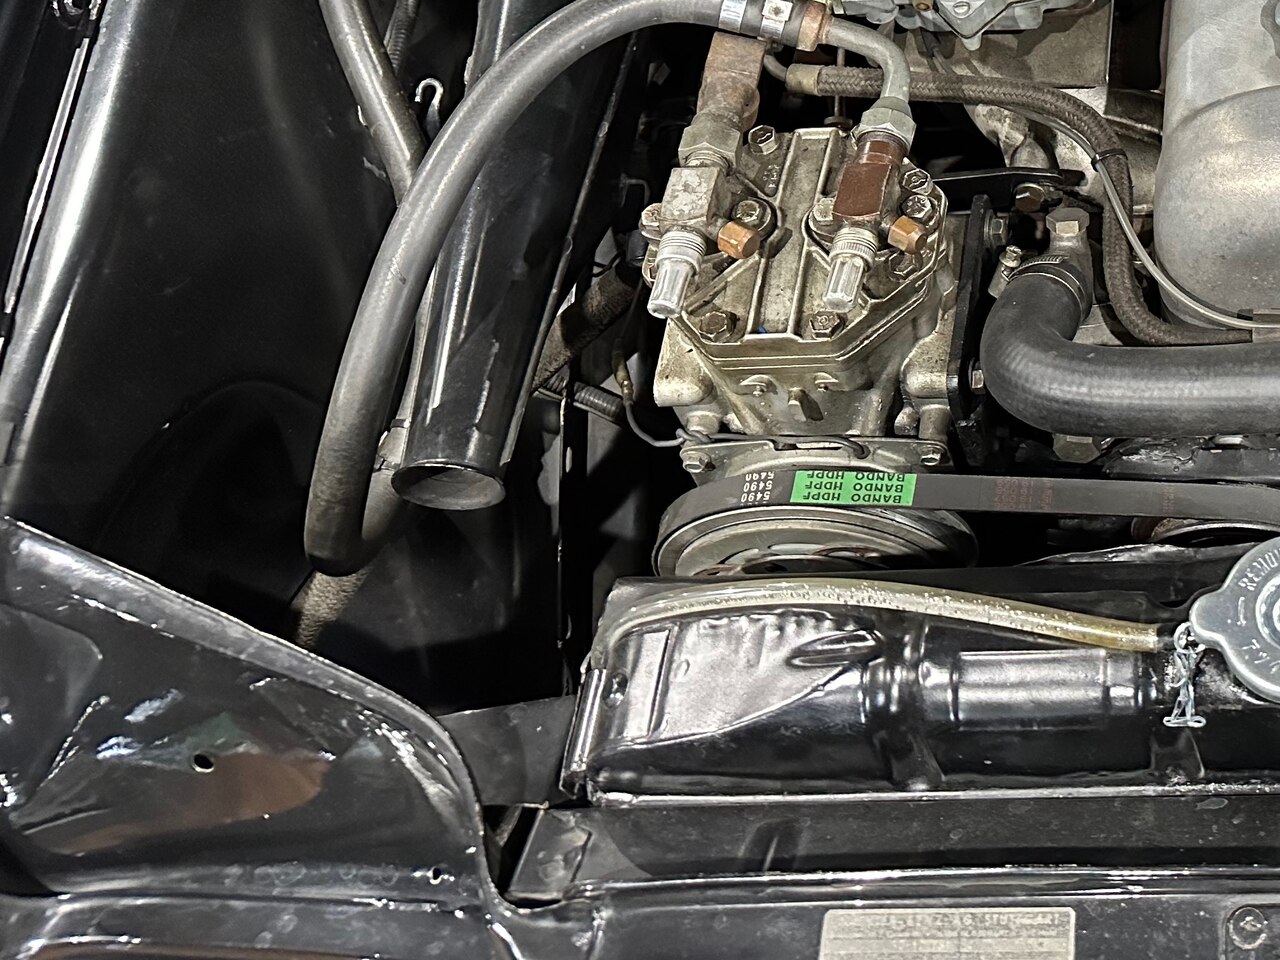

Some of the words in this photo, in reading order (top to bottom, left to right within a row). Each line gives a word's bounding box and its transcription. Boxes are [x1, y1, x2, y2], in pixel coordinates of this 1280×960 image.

[855, 473, 905, 482] BANDO
[743, 481, 773, 492] 5490
[805, 481, 843, 490] HDPF
[853, 483, 904, 493] BANDO
[741, 491, 771, 503] 5490
[802, 491, 841, 501] HDPF
[851, 493, 902, 504] BANDO
